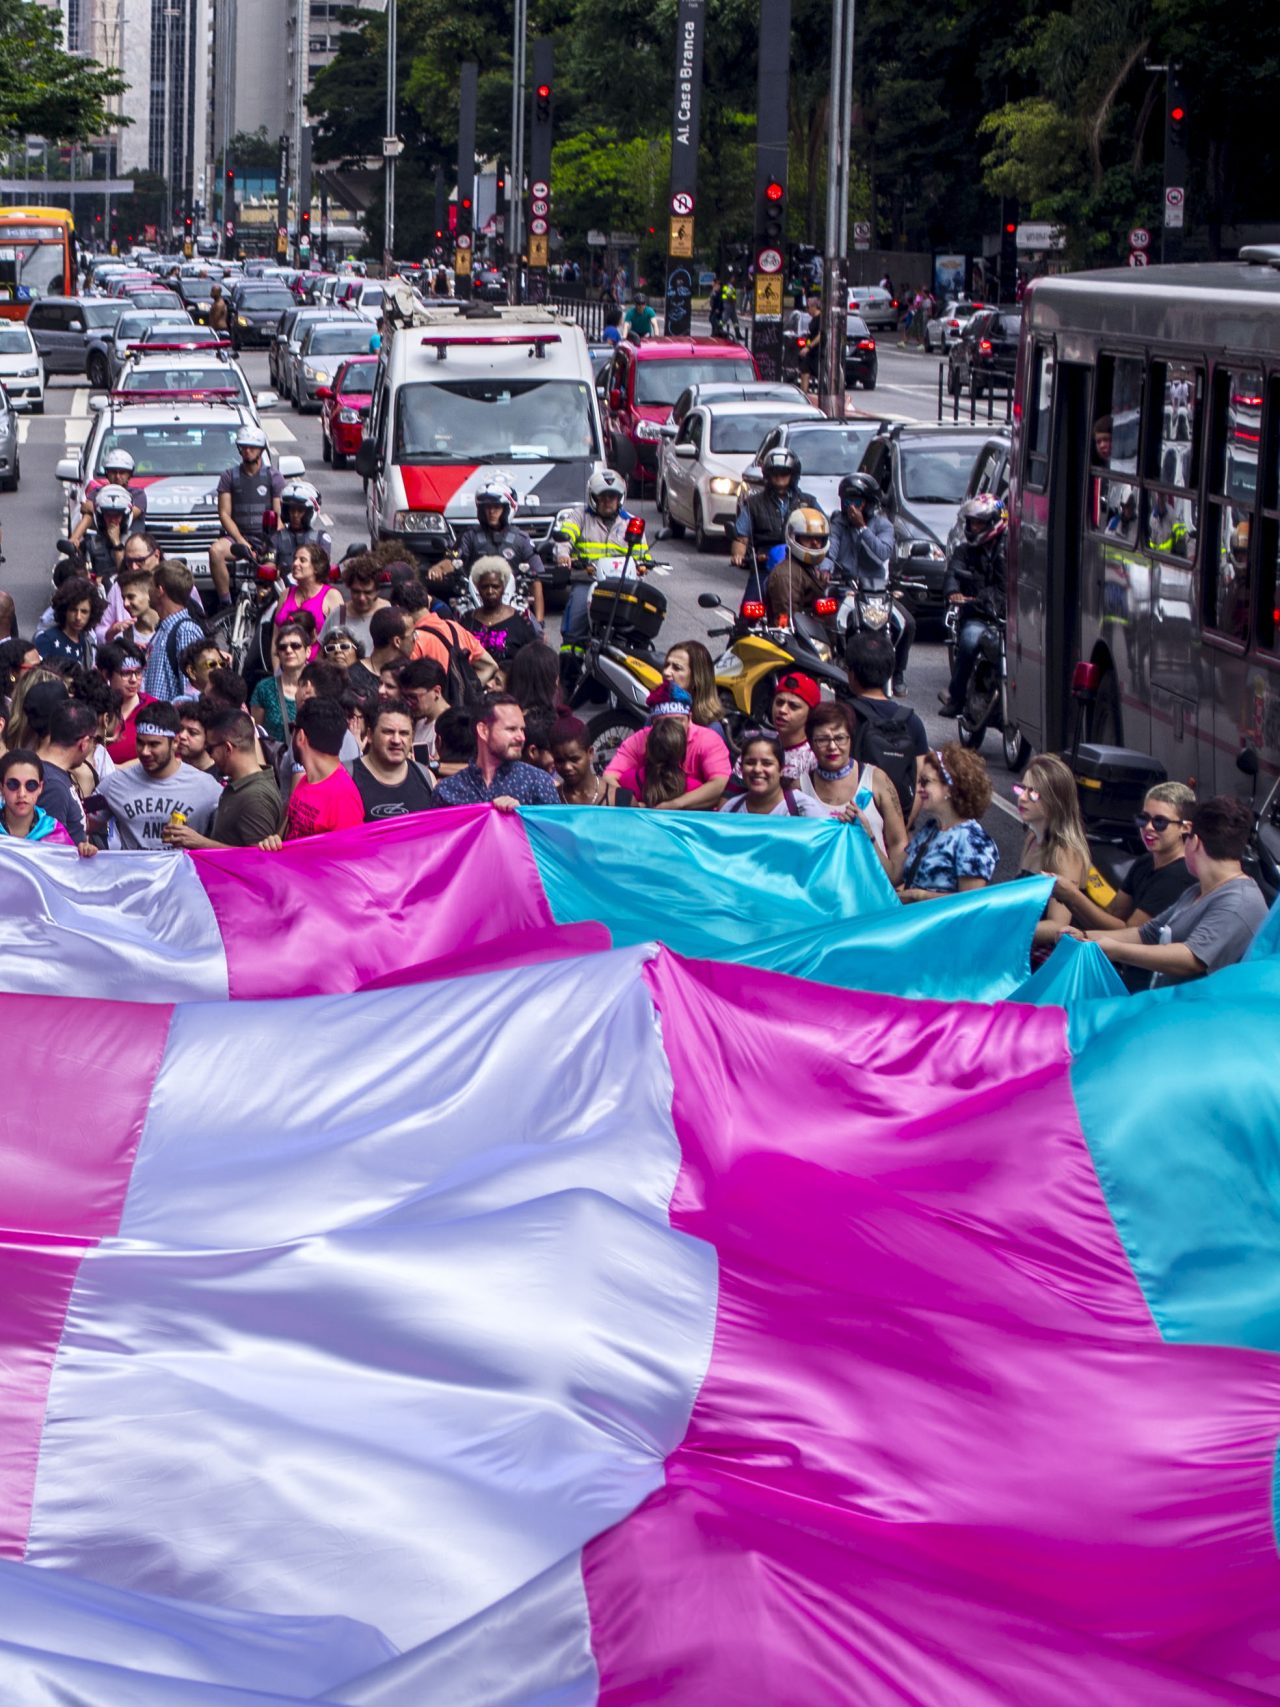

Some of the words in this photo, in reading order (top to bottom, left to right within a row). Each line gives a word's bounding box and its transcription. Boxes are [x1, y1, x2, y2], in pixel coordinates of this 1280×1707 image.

[680, 21, 695, 79] Branca
[678, 82, 691, 120] Casa
[1133, 232, 1148, 243] 50
